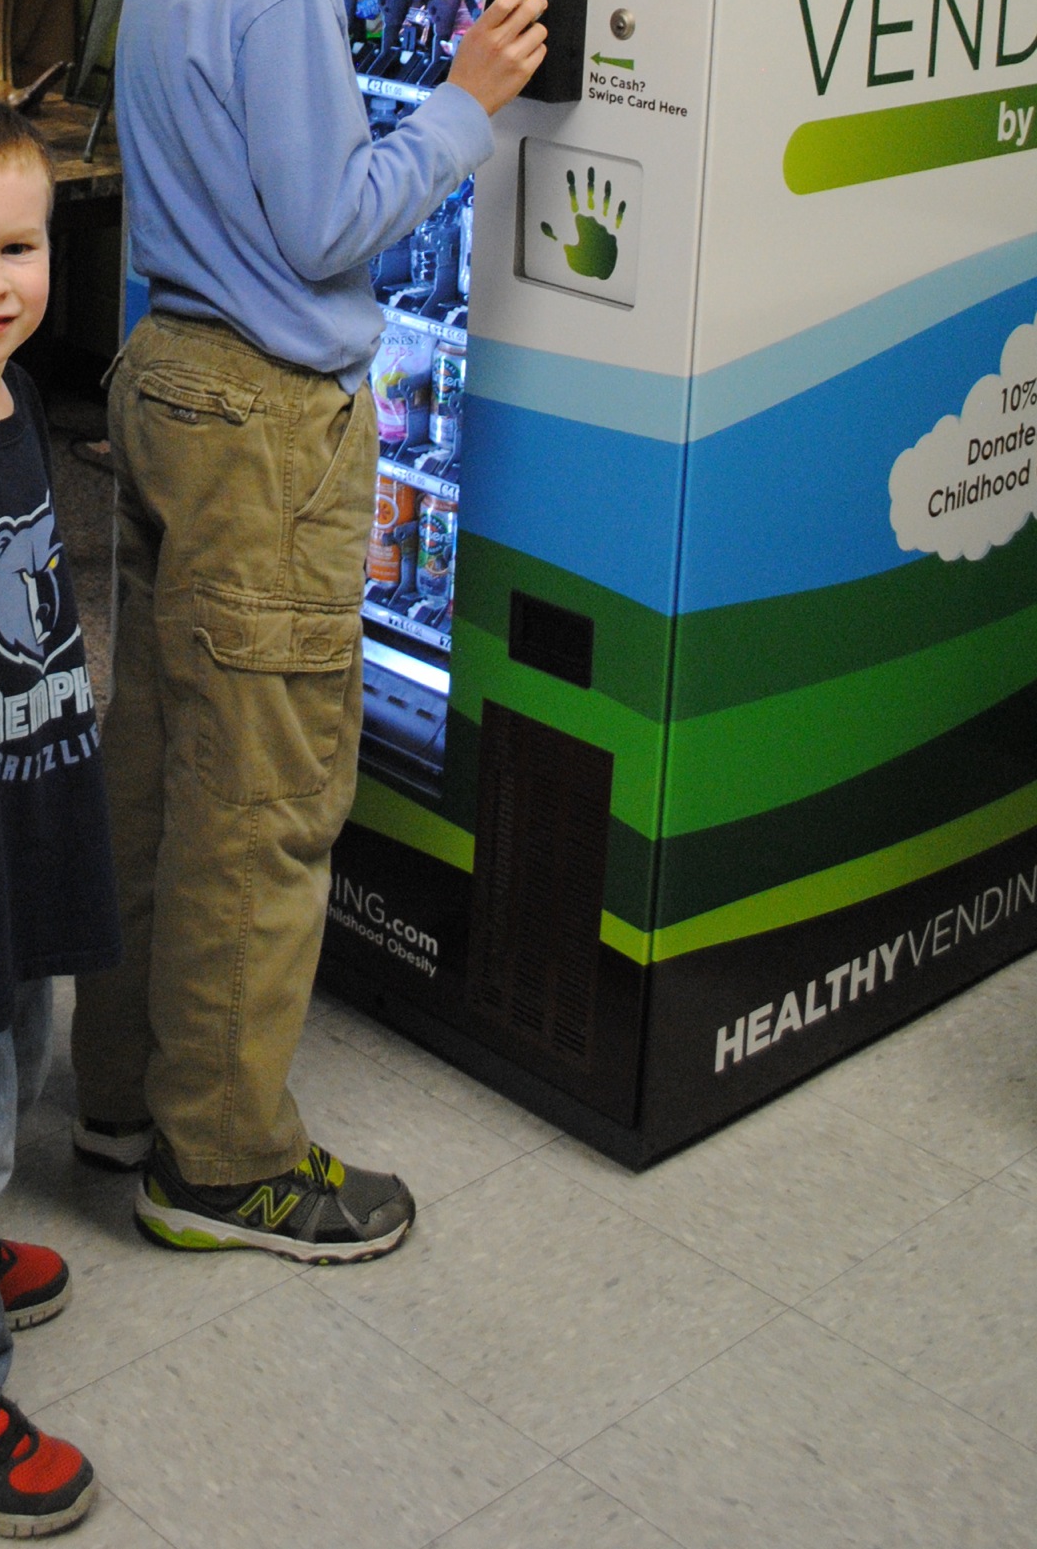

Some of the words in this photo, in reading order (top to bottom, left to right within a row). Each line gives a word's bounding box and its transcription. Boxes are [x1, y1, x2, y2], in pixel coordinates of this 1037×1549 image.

[369, 80, 381, 92] 42
[590, 72, 606, 85] No
[610, 76, 646, 92] Cash?
[589, 87, 624, 104] Swipe
[627, 95, 656, 111] Card
[659, 100, 688, 117] Here
[997, 101, 1035, 146] by
[927, 459, 1031, 518] Childhood
[387, 938, 437, 978] Obesity
